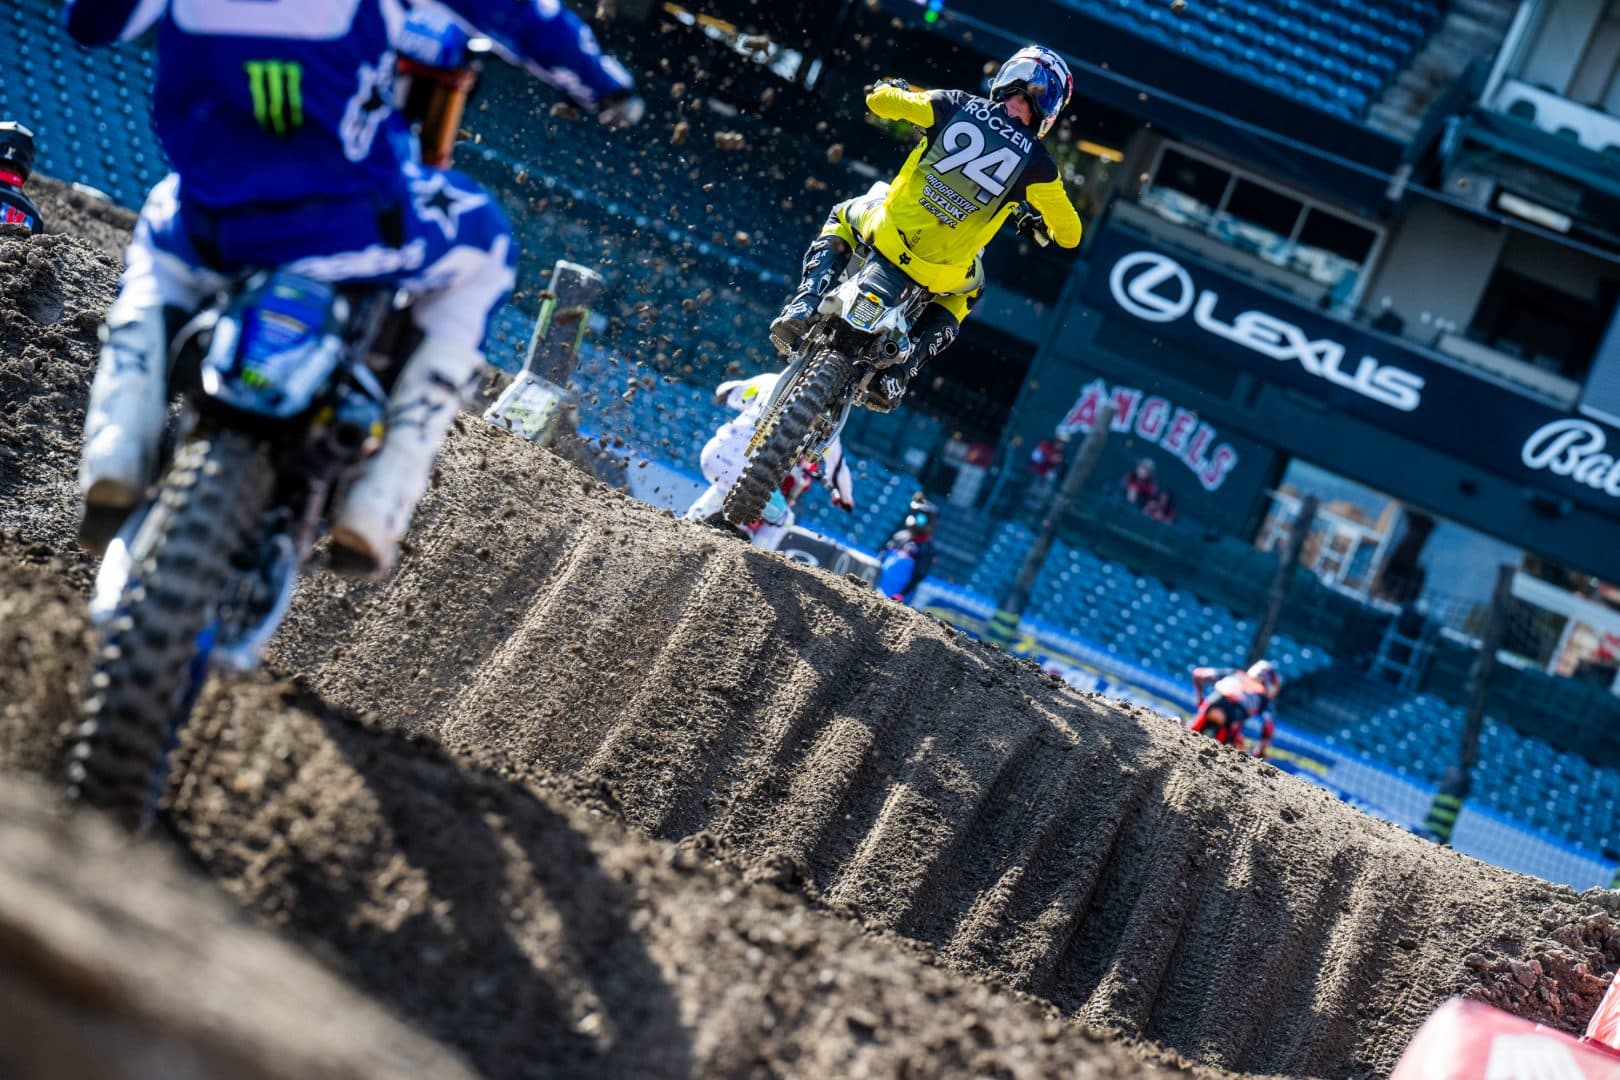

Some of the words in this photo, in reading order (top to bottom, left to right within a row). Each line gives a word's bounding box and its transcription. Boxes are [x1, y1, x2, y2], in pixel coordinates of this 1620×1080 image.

[923, 186, 967, 221] SUZUKI
[925, 174, 980, 214] PROGRESSIVE
[932, 121, 1022, 205] 94
[1194, 290, 1425, 412] LEXUS
[1055, 378, 1239, 491] ANGELS
